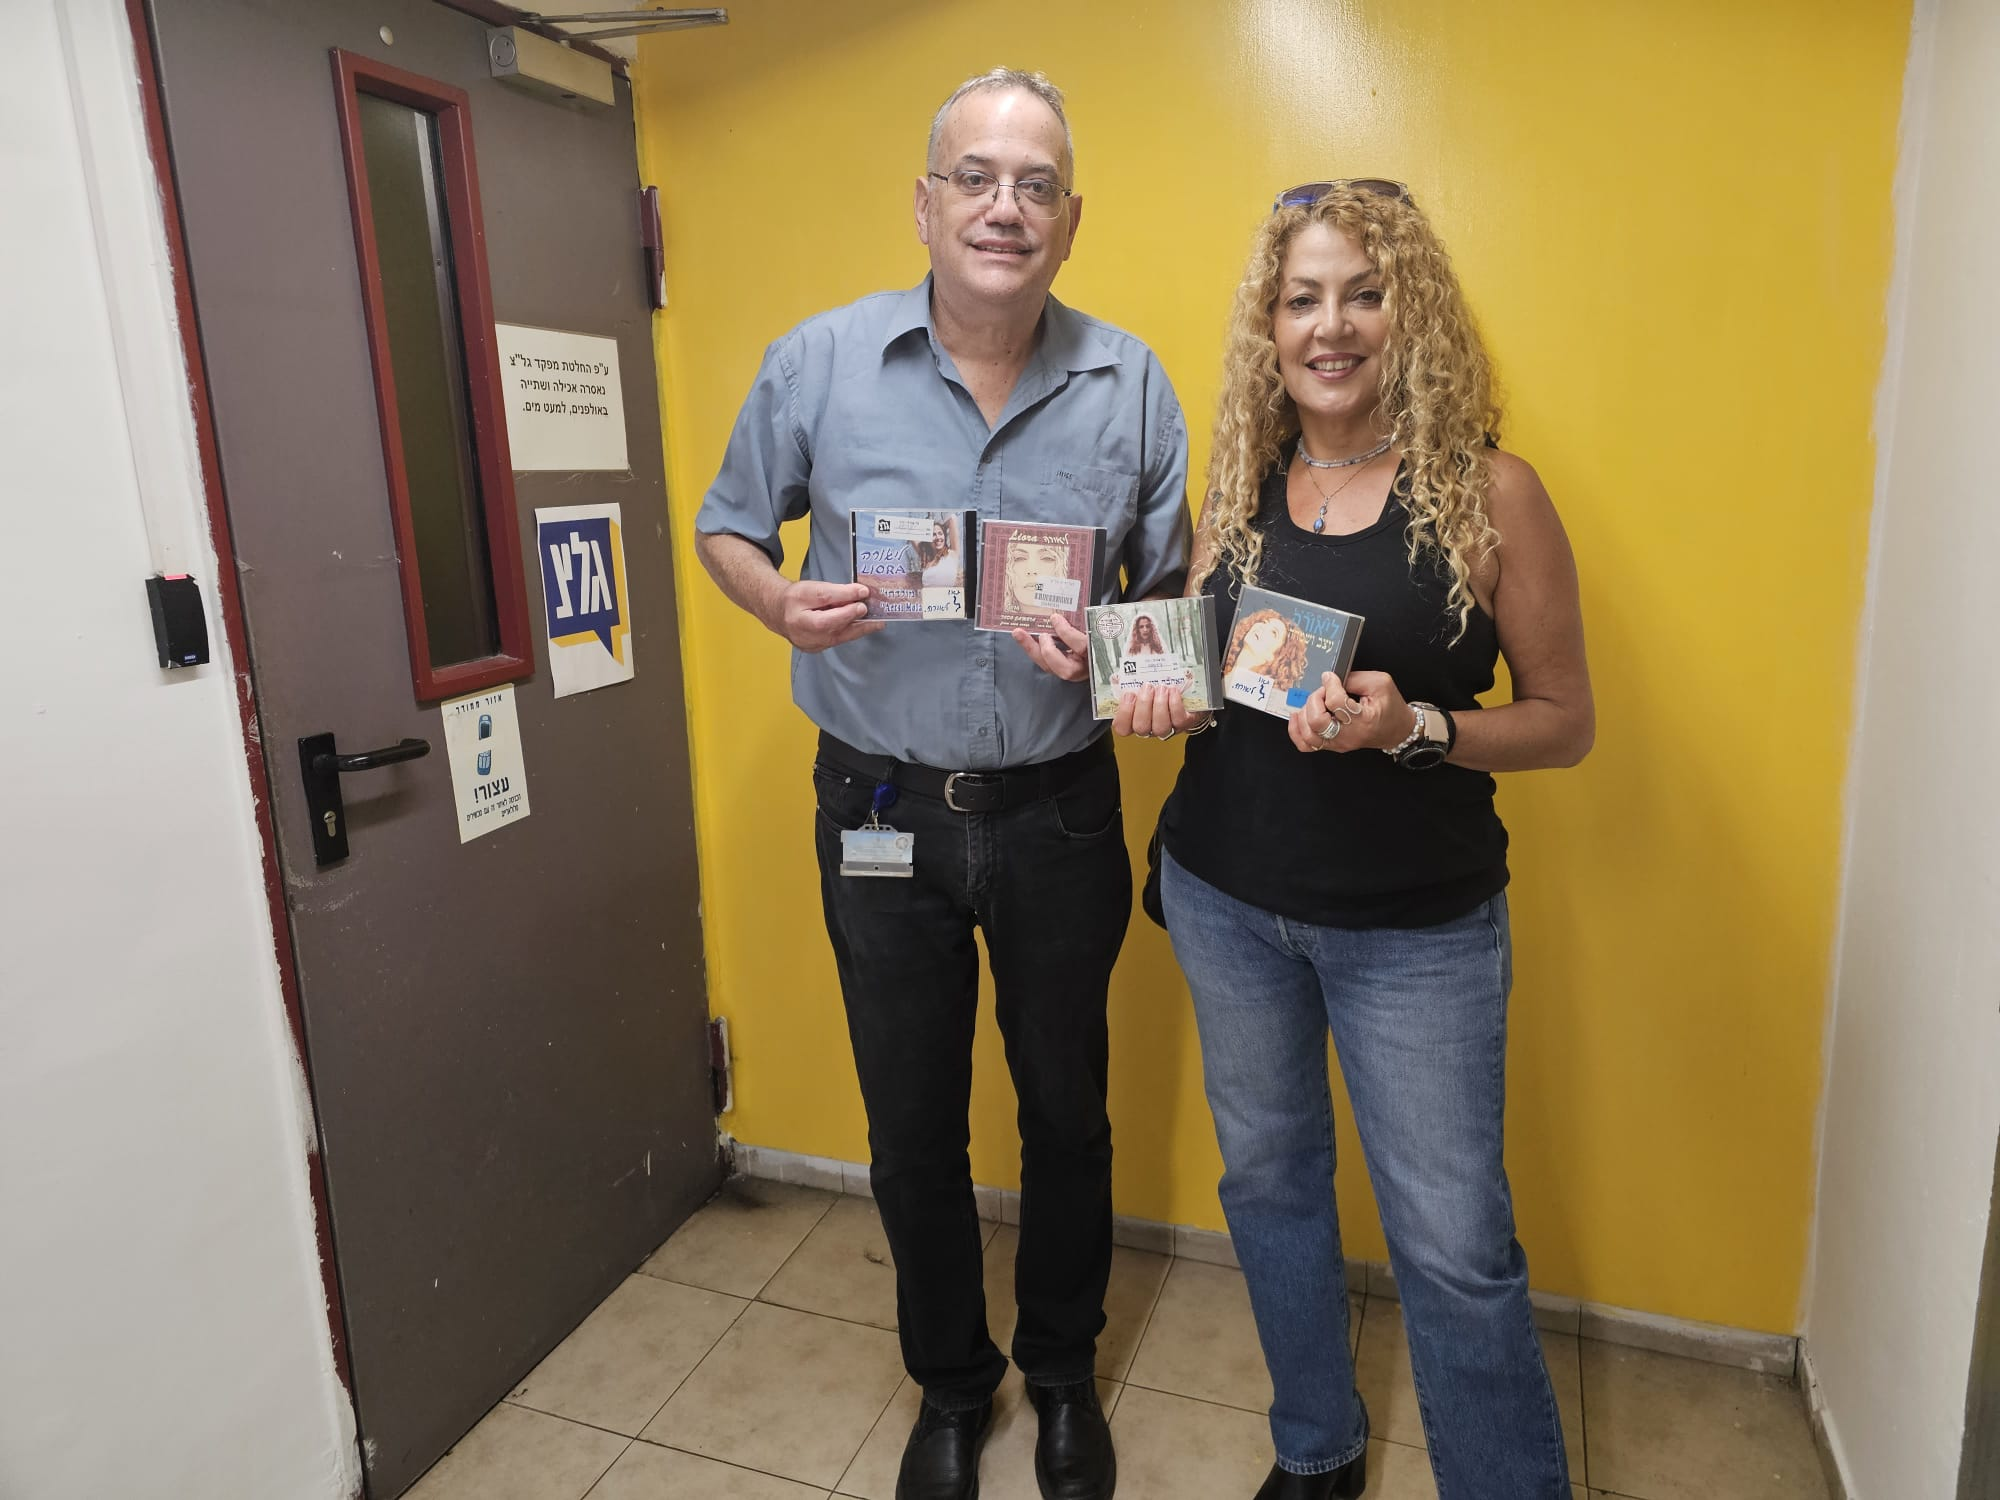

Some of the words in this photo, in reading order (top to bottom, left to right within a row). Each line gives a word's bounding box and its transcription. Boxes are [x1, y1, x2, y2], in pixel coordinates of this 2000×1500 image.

[509, 354, 533, 368] גל"צ
[535, 358, 560, 372] מפקד
[562, 360, 592, 374] החלטת
[594, 362, 609, 376] ע"פ
[520, 378, 551, 391] ושתייה
[553, 380, 578, 393] אכילה
[580, 384, 606, 396] נאסרה
[522, 401, 541, 412] מים.
[543, 401, 567, 414] למעט
[569, 403, 609, 417] באולפנים,
[1009, 529, 1038, 542] Liora
[860, 545, 911, 561] ליאורה
[550, 531, 613, 619] גלצ
[861, 563, 906, 575] LIORA
[474, 776, 510, 804] עצור!
